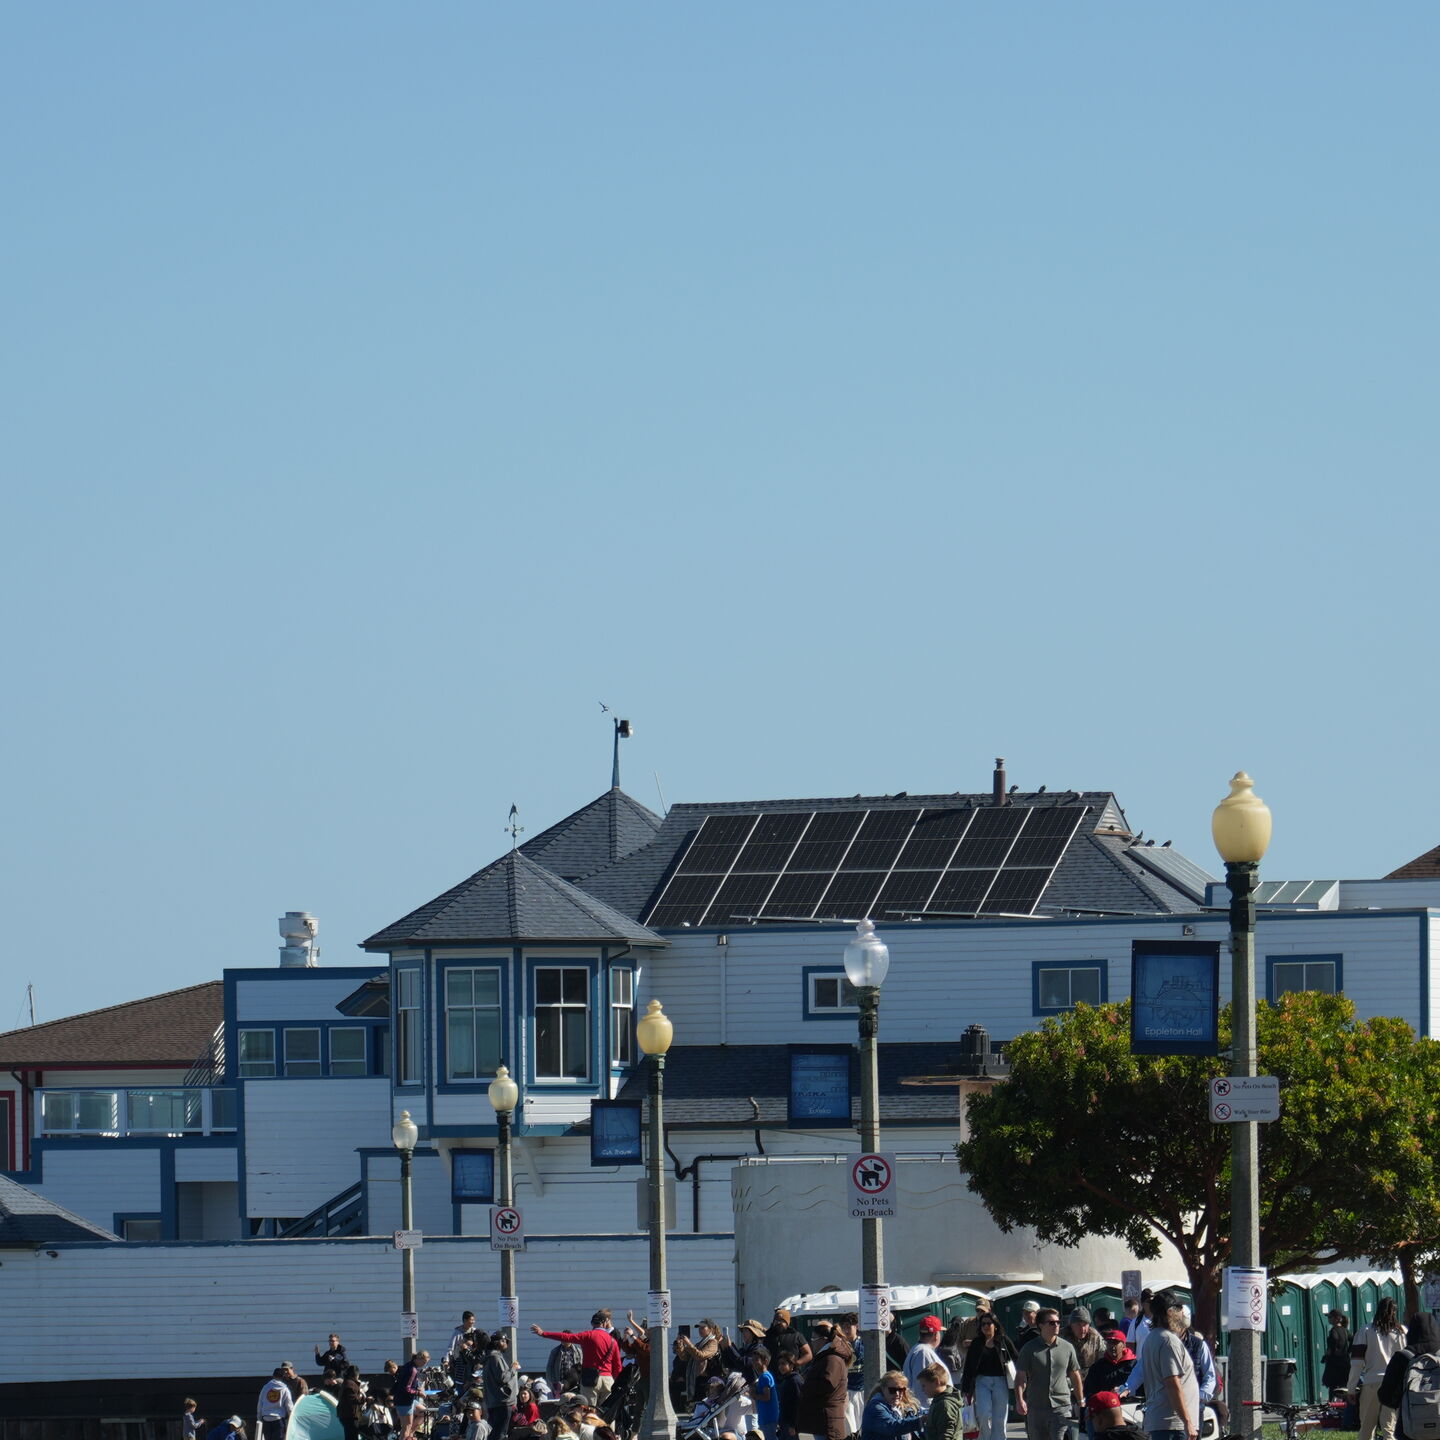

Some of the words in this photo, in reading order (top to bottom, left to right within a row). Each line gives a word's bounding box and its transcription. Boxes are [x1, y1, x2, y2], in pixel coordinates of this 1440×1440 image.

[1145, 1027, 1184, 1037] Eppleton
[1186, 1025, 1203, 1036] Hall
[856, 1197, 869, 1206] No
[871, 1197, 889, 1205] Pets
[852, 1209, 866, 1217] On
[867, 1208, 894, 1217] Beach
